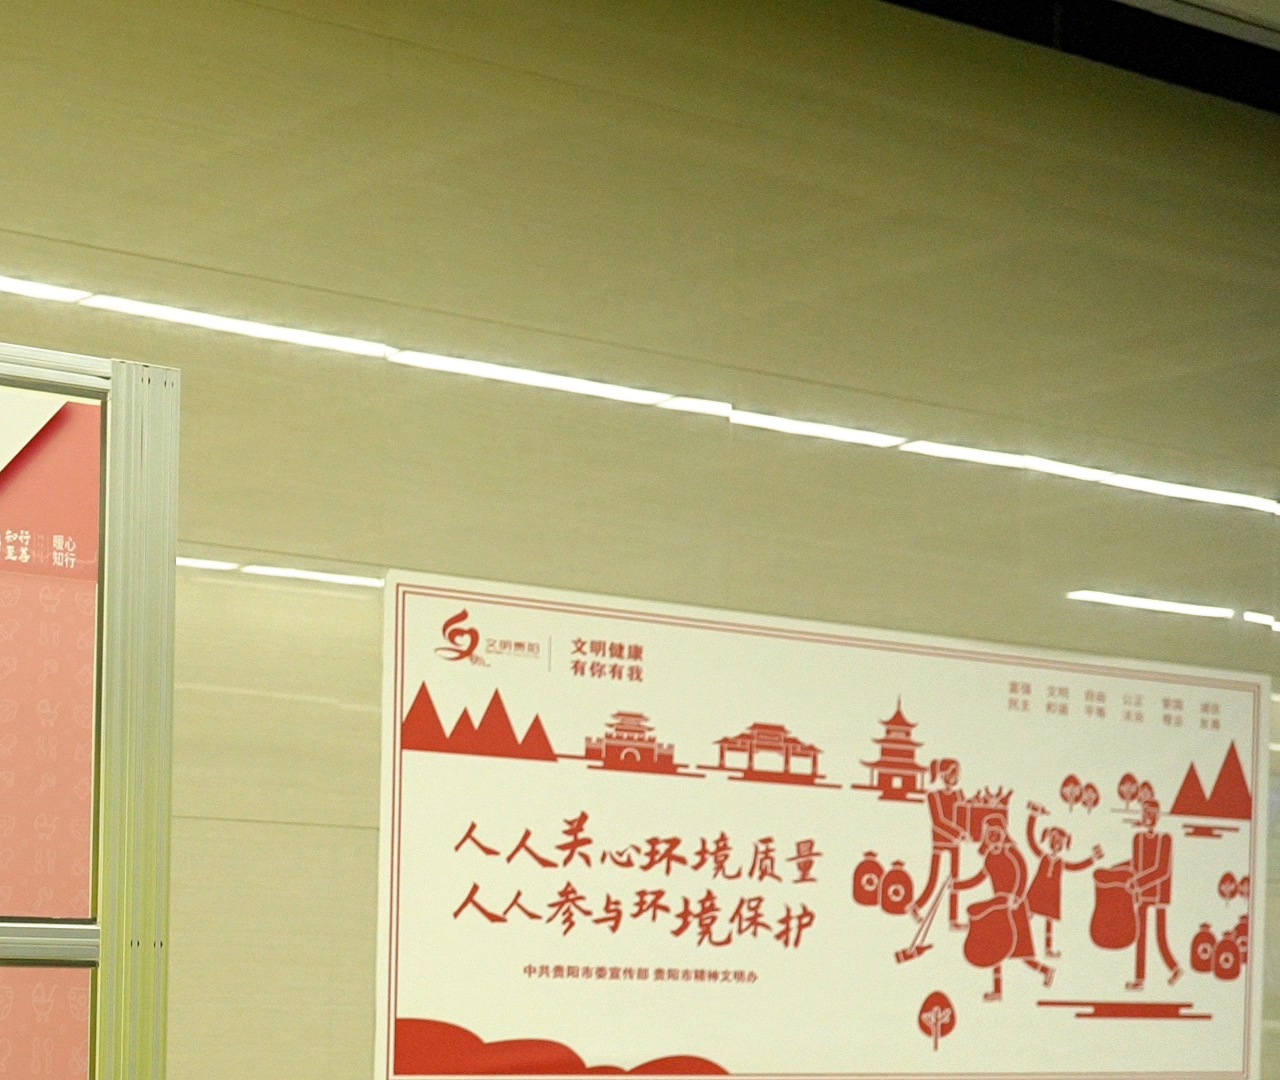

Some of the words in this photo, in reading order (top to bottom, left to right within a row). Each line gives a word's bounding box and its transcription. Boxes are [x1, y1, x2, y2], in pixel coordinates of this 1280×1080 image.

[53, 550, 76, 569] 知行
[571, 637, 644, 661] 文明健康
[571, 660, 644, 682] 有你有我
[454, 811, 823, 884] 人人关心环境质量
[453, 881, 816, 948] 人人参与环境保护
